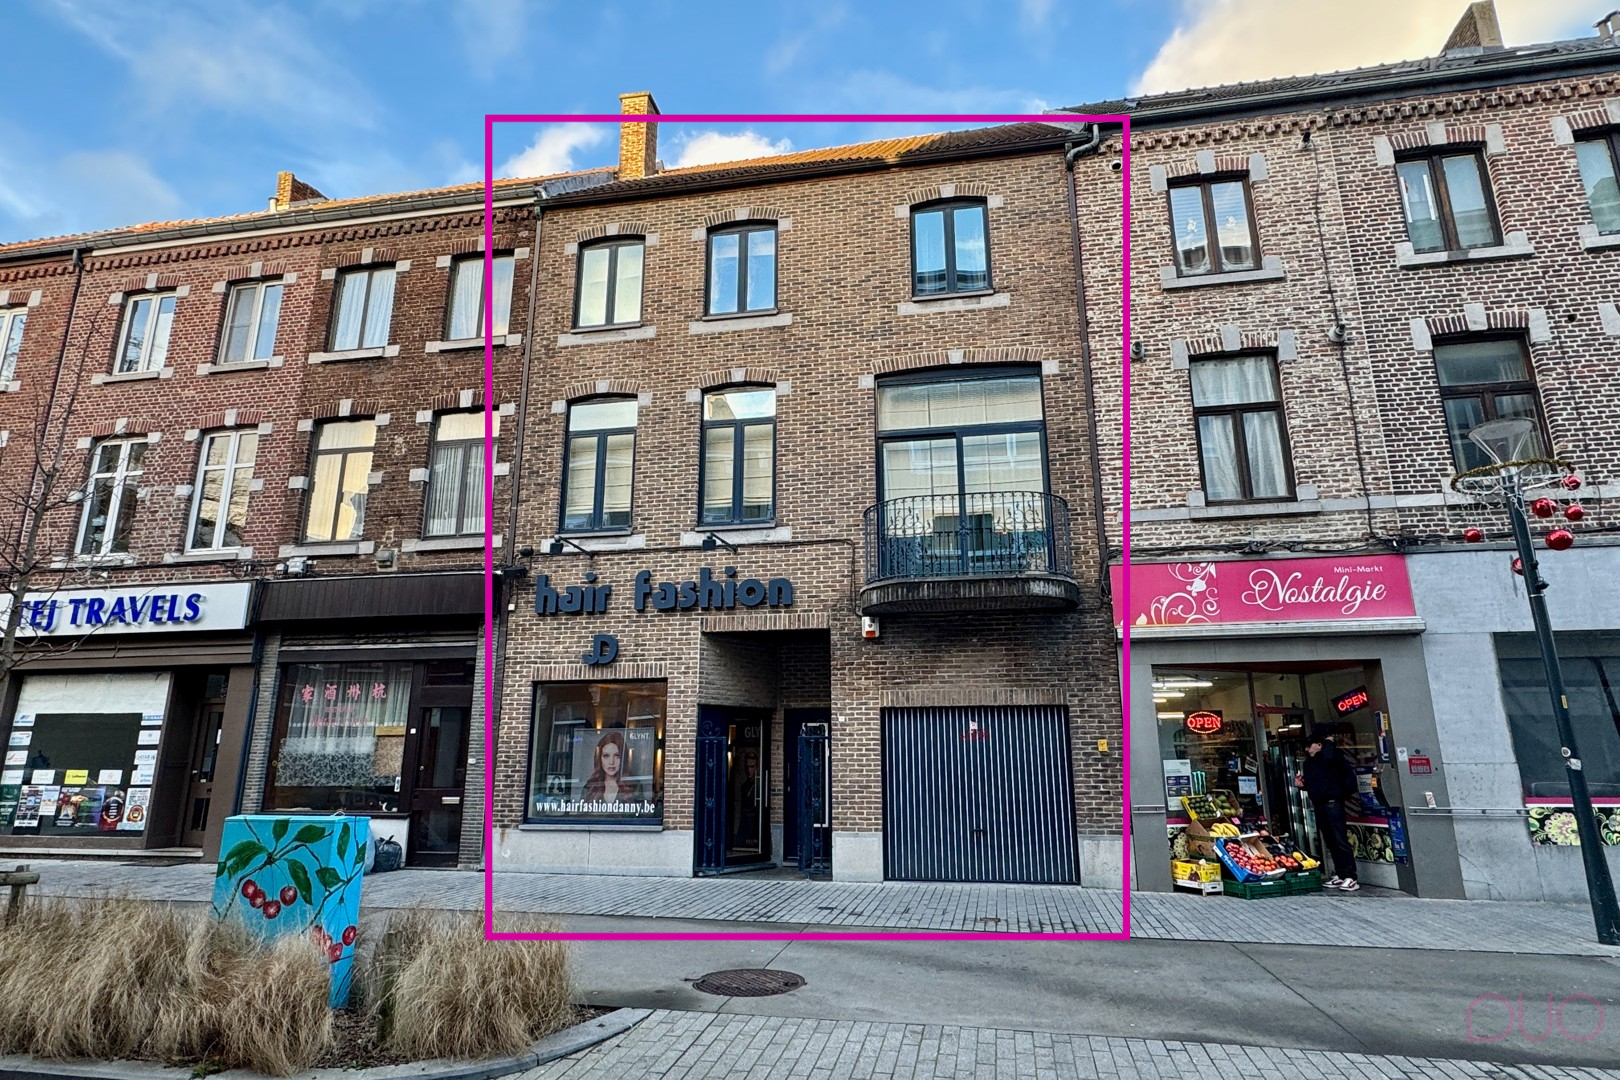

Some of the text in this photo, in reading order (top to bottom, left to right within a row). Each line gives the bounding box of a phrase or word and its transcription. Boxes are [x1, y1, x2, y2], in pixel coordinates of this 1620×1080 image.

[1334, 565, 1384, 573] Mini-Markt
[534, 566, 793, 615] hair fashion
[1241, 568, 1387, 615] Nostalgie
[69, 593, 202, 625] TRAVELS
[582, 633, 619, 666] JD
[1337, 692, 1368, 711] OPEN
[1187, 716, 1221, 729] OPEN
[629, 731, 649, 741] GLYNT
[744, 726, 761, 738] GLY
[536, 798, 656, 816] www.hairfashiondanny.be
